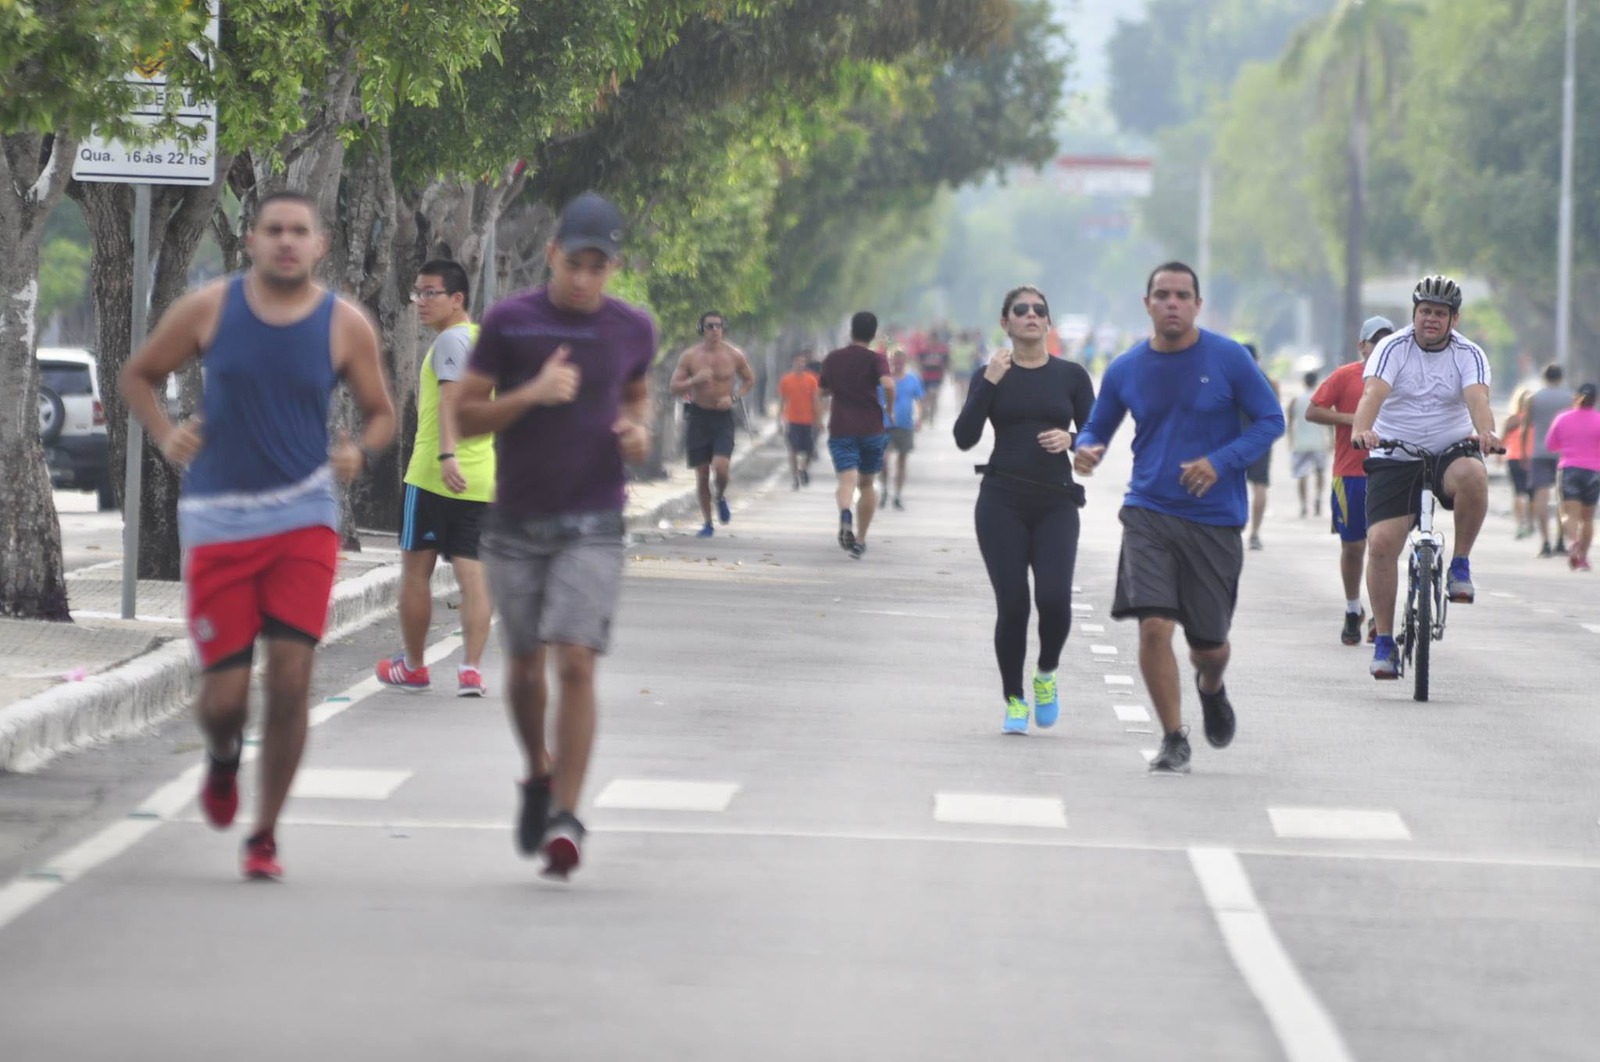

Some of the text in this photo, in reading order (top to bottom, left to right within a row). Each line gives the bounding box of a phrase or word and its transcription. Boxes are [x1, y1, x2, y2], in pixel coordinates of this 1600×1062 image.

[81, 148, 207, 166] Qua. 16 às 22 hs
